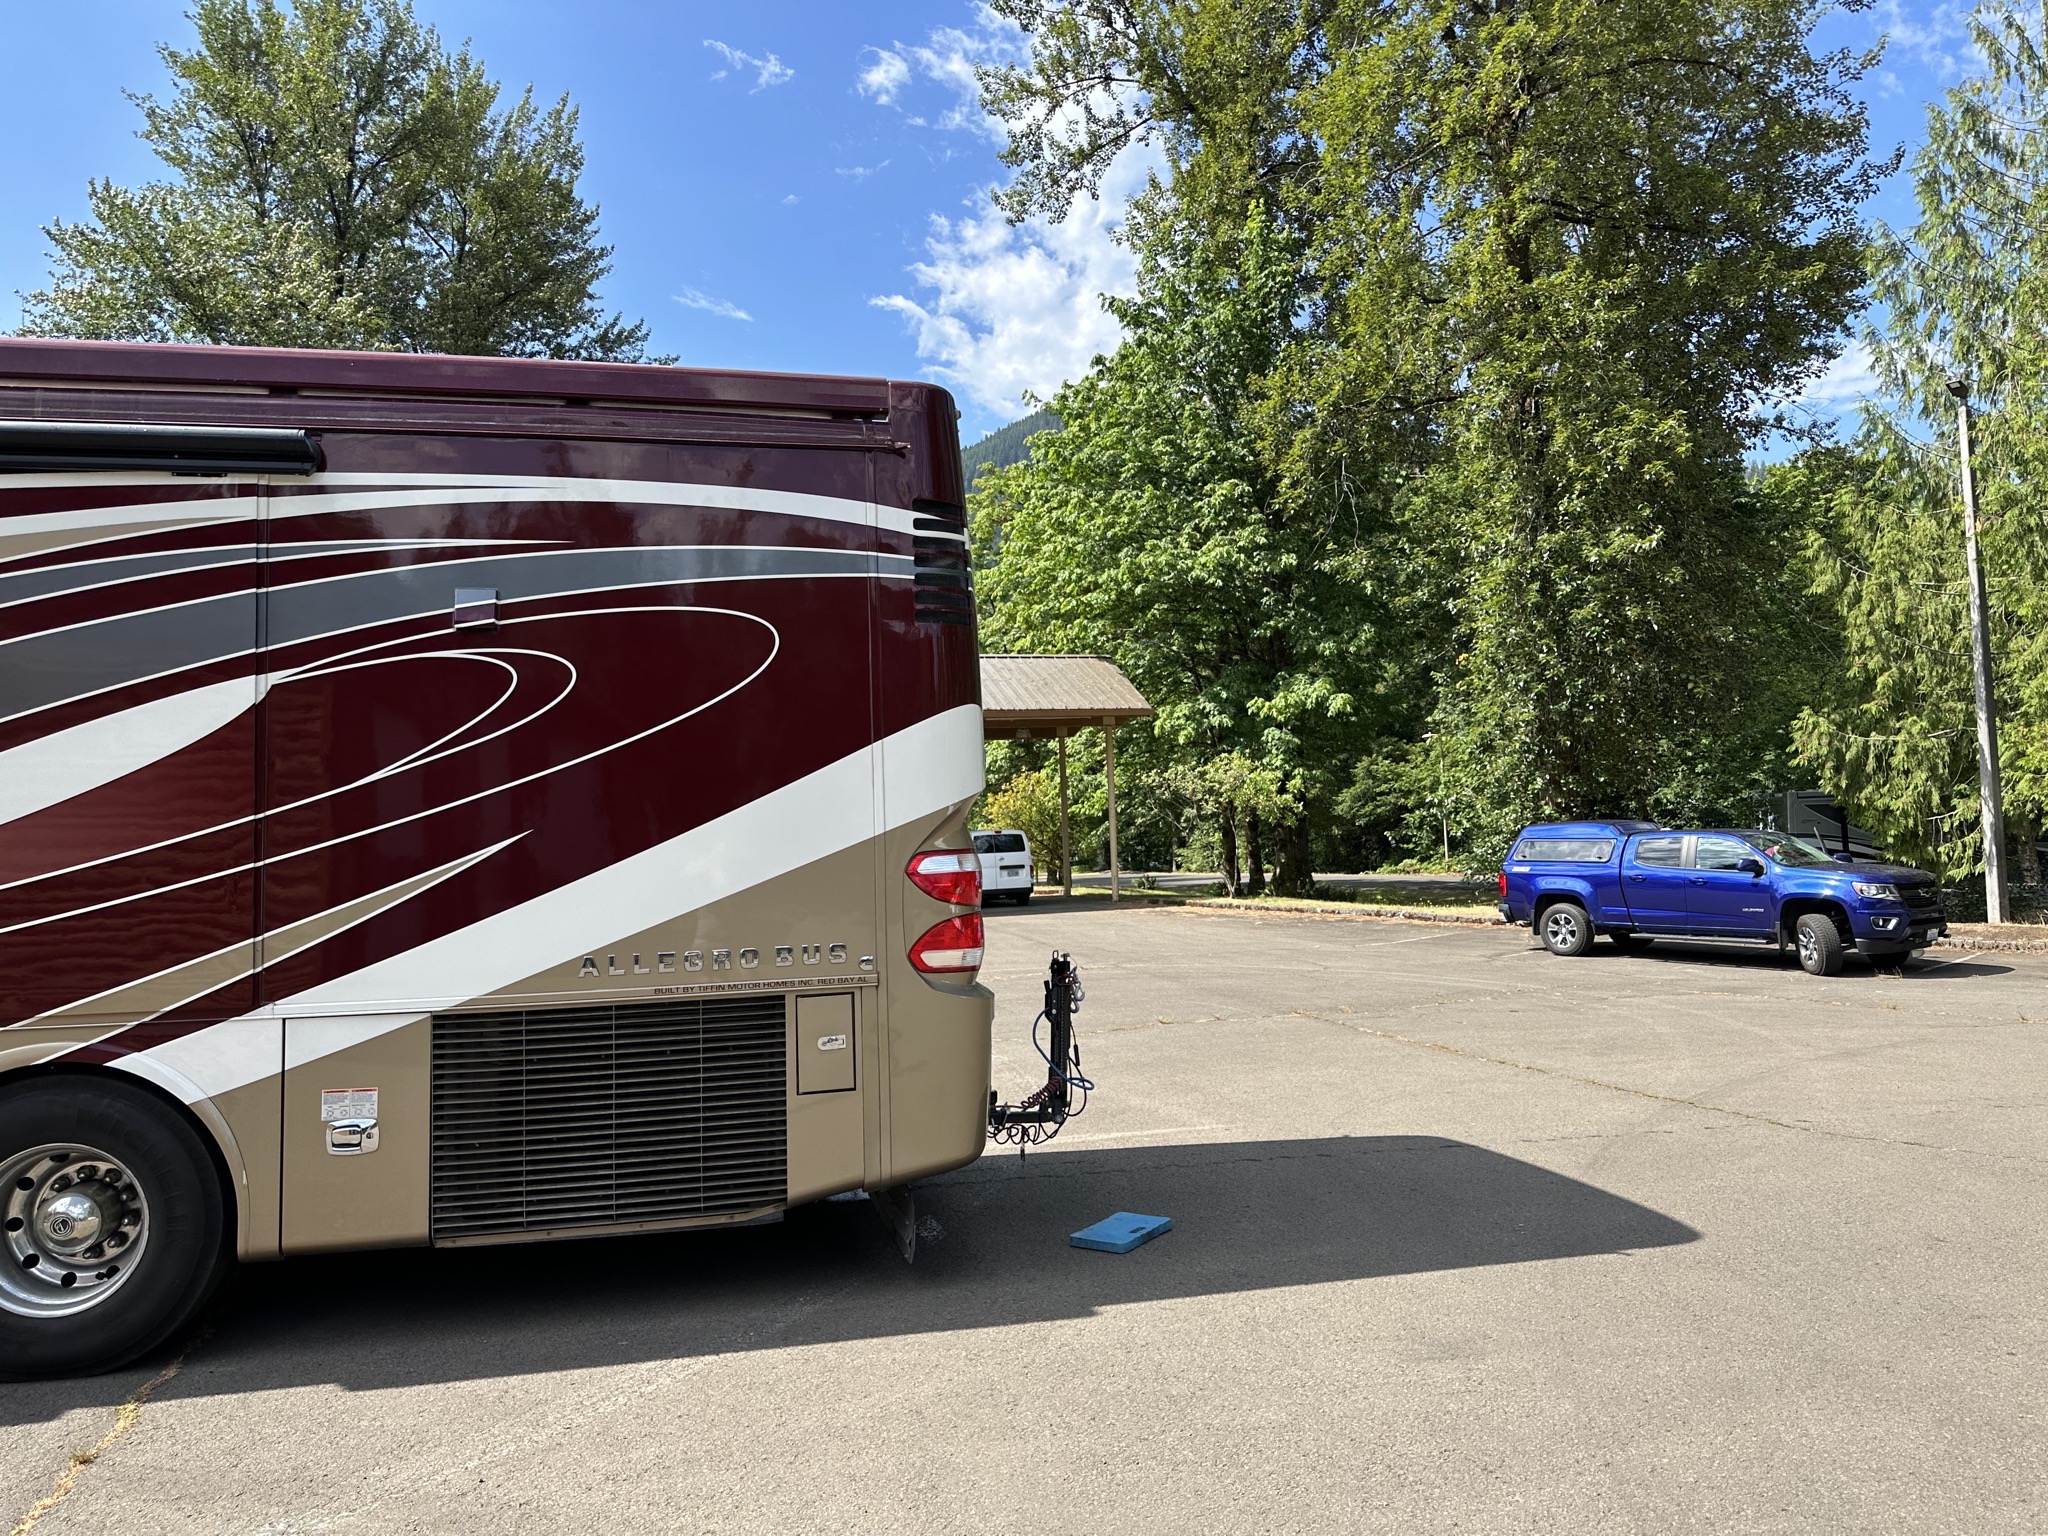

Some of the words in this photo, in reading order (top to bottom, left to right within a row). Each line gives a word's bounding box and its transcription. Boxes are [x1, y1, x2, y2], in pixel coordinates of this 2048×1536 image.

[578, 947, 760, 978] ALLEGRO
[774, 942, 848, 967] BUS
[654, 986, 680, 995] BUILT
[682, 985, 695, 993] BY
[698, 984, 725, 992] TIFFIN
[727, 982, 761, 990] MOTOR
[762, 980, 796, 988] HOMES
[837, 976, 855, 984] BAY
[75, 1107, 188, 1251] MICHELIN
